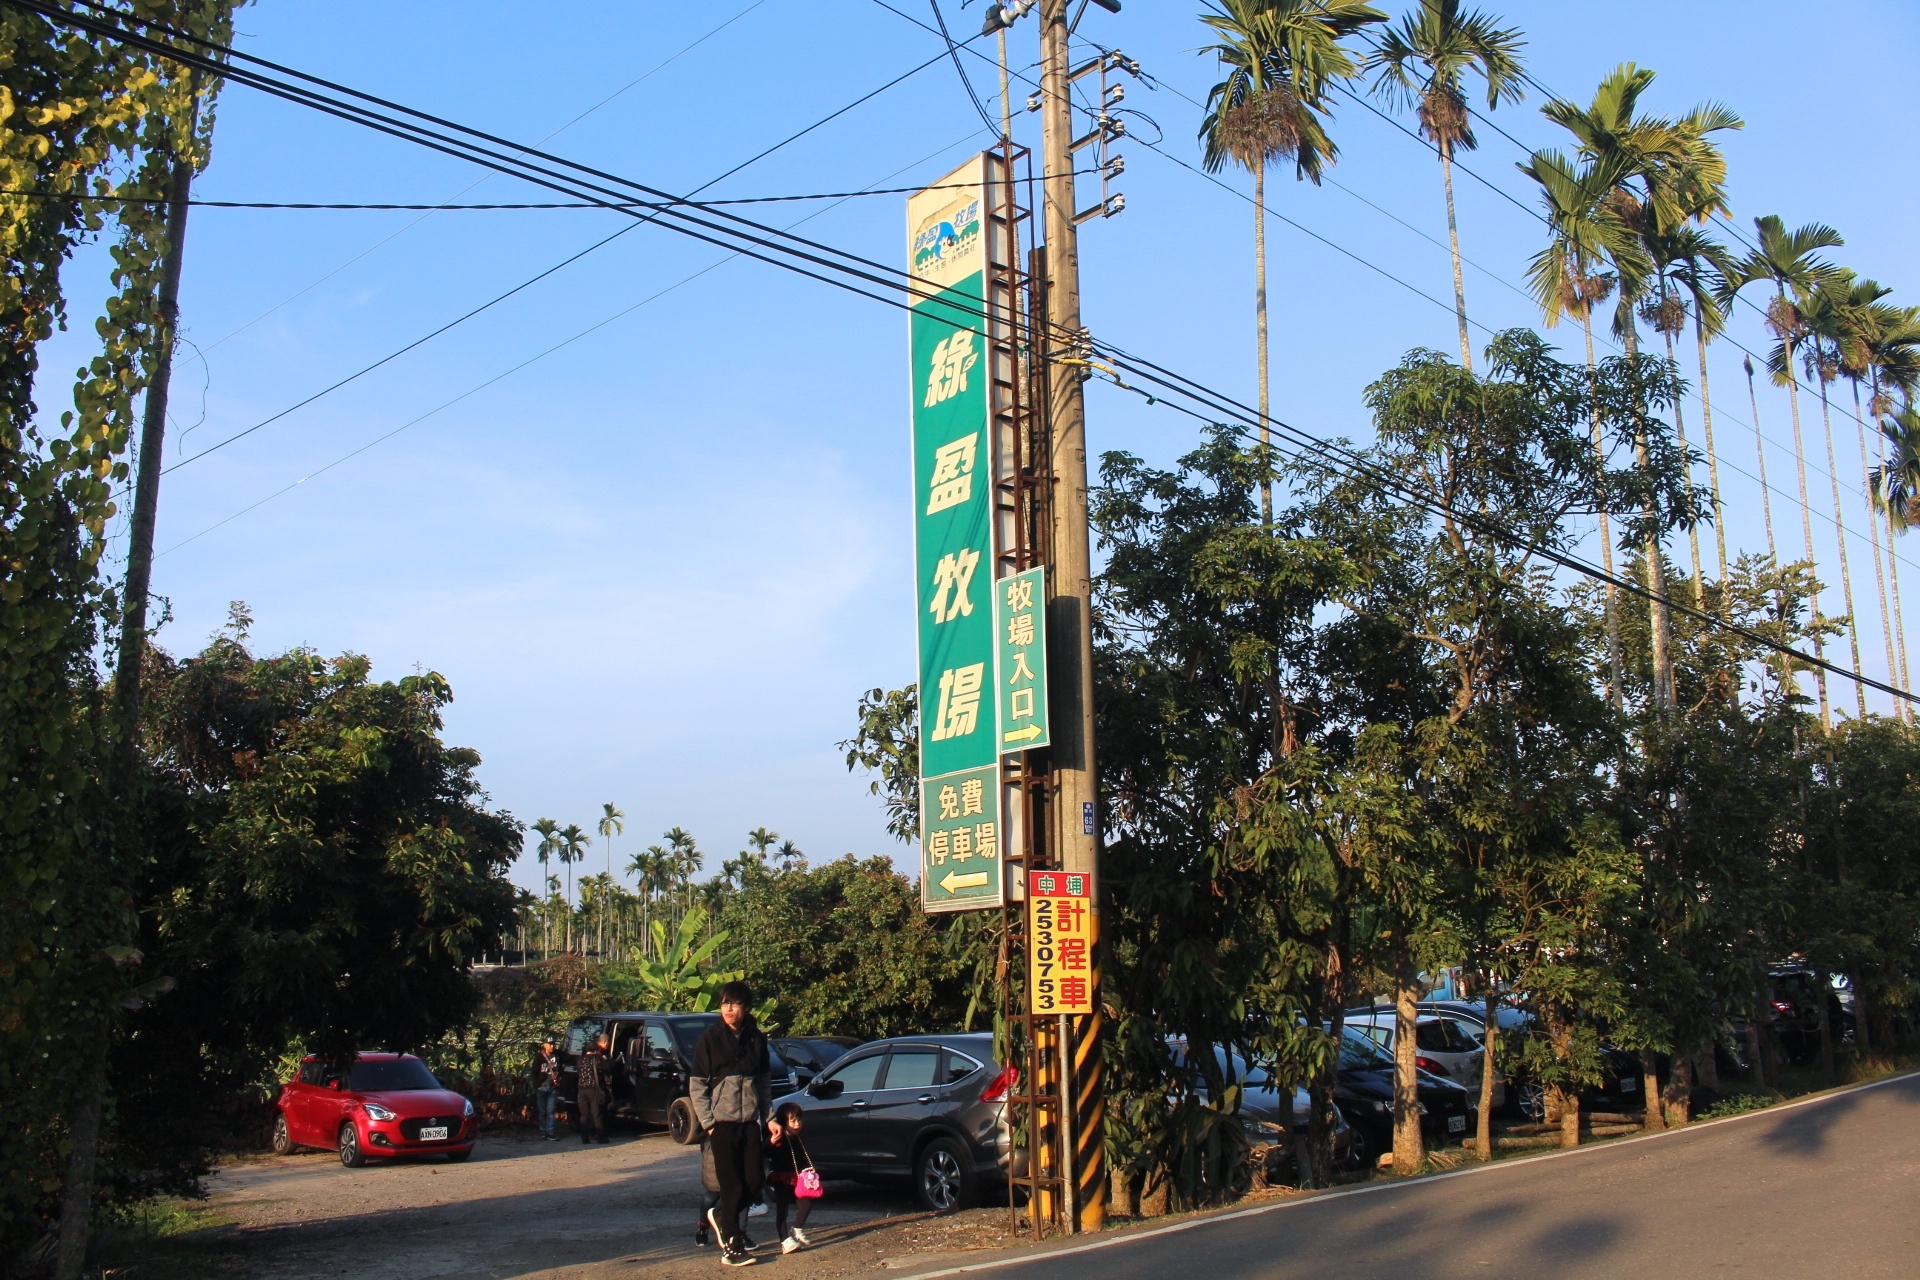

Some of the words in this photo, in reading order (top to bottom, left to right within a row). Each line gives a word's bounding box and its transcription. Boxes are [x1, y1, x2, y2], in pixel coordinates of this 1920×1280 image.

[924, 326, 985, 743] 綠盈牧場
[1007, 579, 1035, 722] 牧場入口
[928, 822, 997, 867] 停車場
[938, 778, 983, 822] 免費
[1038, 874, 1084, 896] 中埔
[1036, 899, 1055, 1010] 2530753
[1056, 900, 1088, 1009] 計程車
